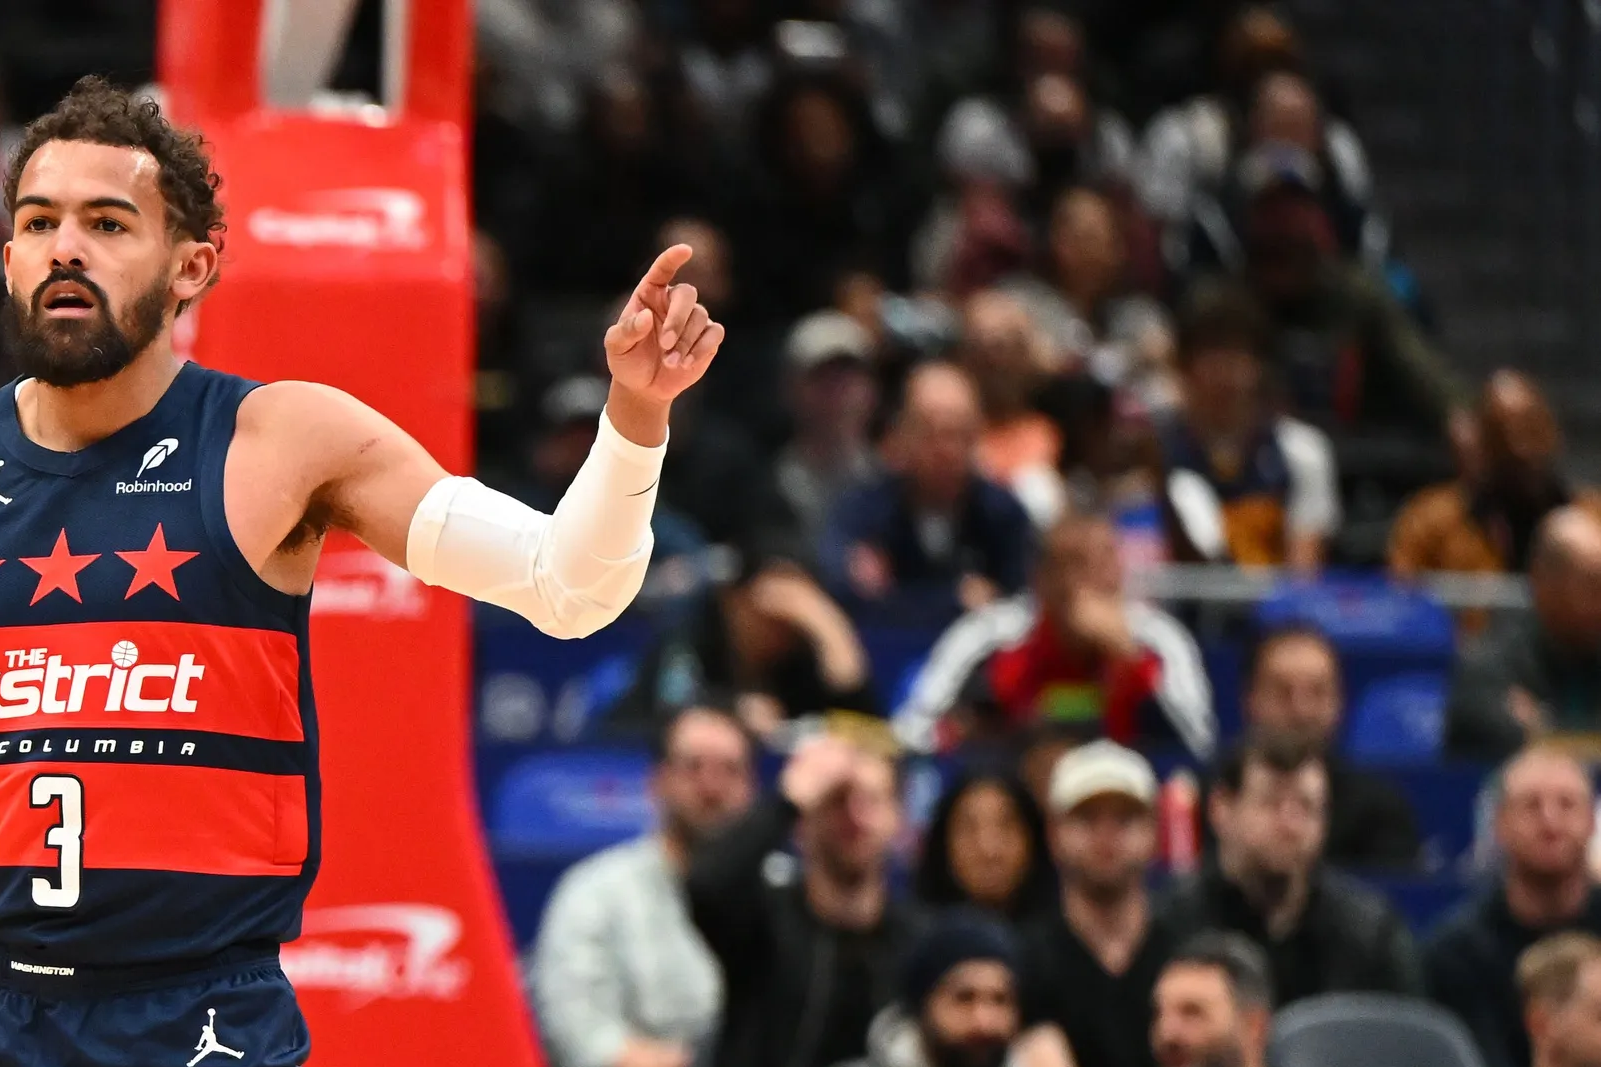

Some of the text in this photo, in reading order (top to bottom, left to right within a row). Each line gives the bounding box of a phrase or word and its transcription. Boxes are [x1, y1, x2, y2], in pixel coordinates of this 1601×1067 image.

[115, 478, 193, 495] Robinhood
[4, 647, 49, 668] THE
[30, 774, 85, 910] 3
[10, 960, 75, 976] WASHINGTON
